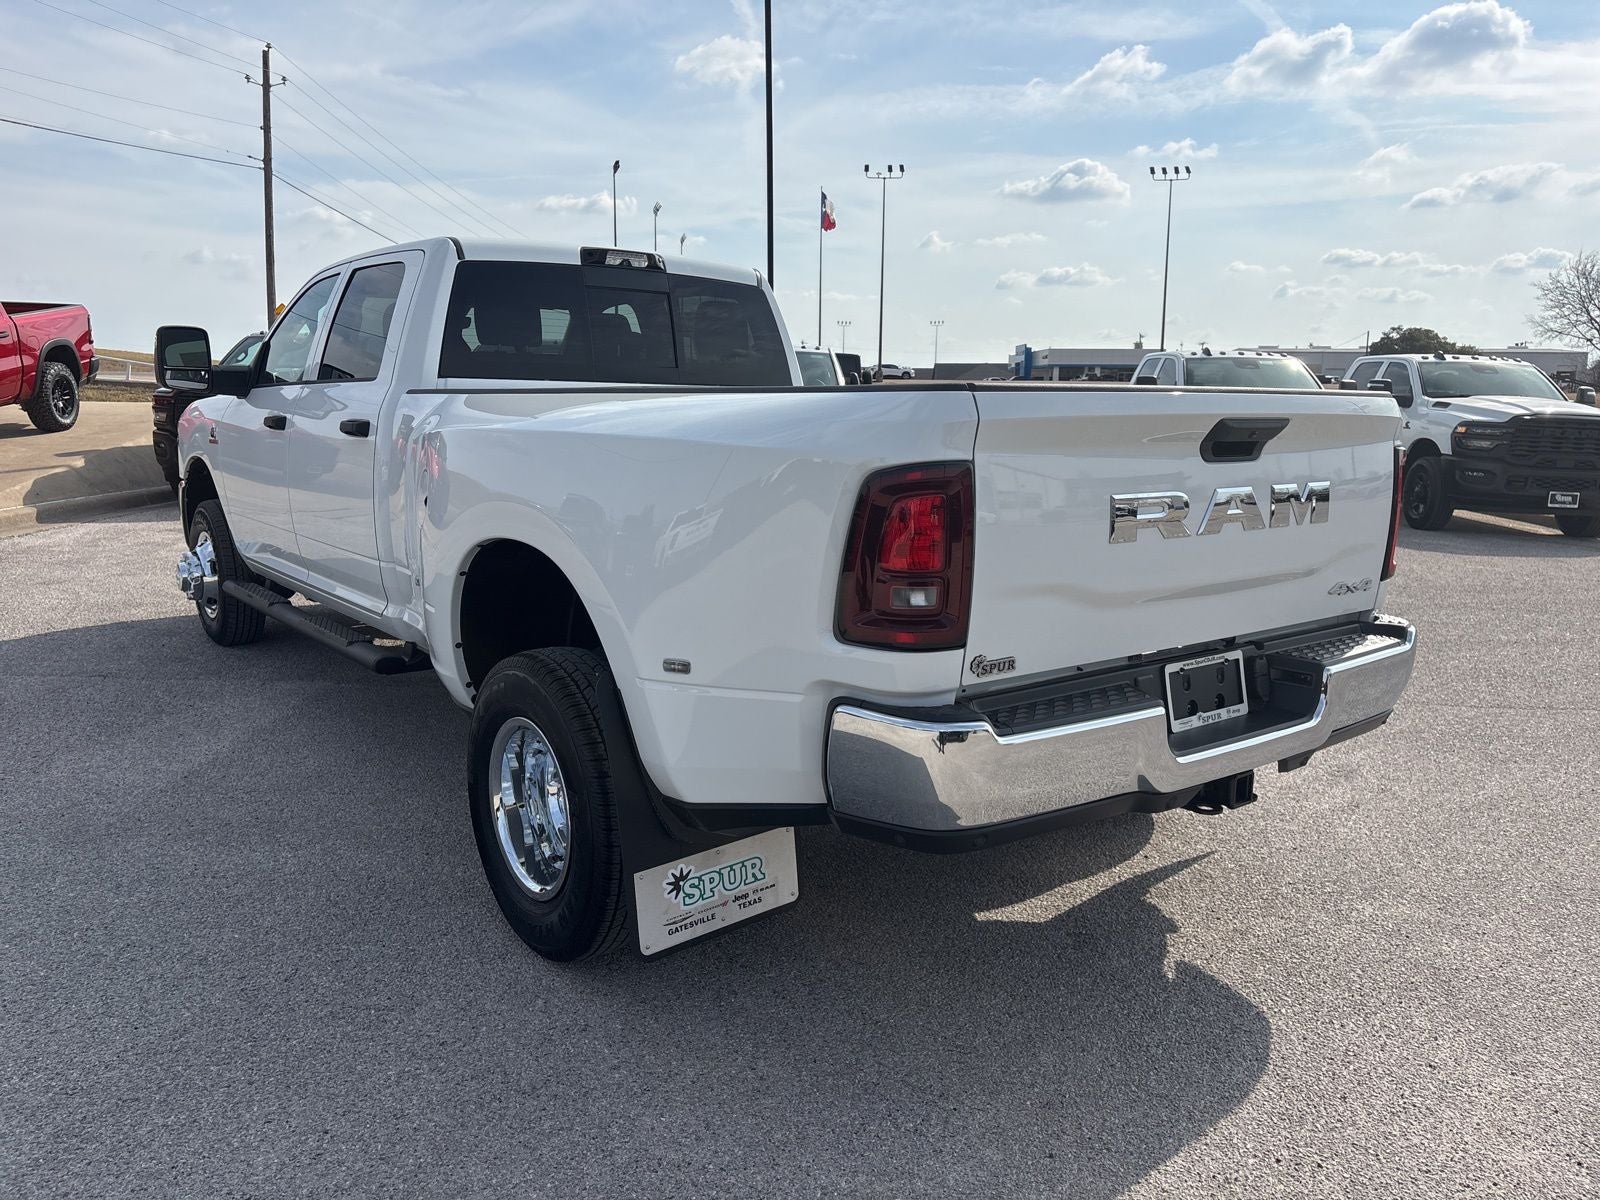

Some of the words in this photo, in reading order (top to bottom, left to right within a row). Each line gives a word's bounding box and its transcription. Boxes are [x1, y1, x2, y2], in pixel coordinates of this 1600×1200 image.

[1109, 480, 1331, 544] RAM
[1327, 577, 1372, 596] 4x4
[981, 659, 1016, 676] SPUR
[1201, 712, 1222, 724] SPUR
[681, 856, 766, 906] SPUR
[732, 892, 750, 904] Jeep
[667, 912, 717, 936] GATESVILLE
[737, 896, 763, 910] TEXAS
